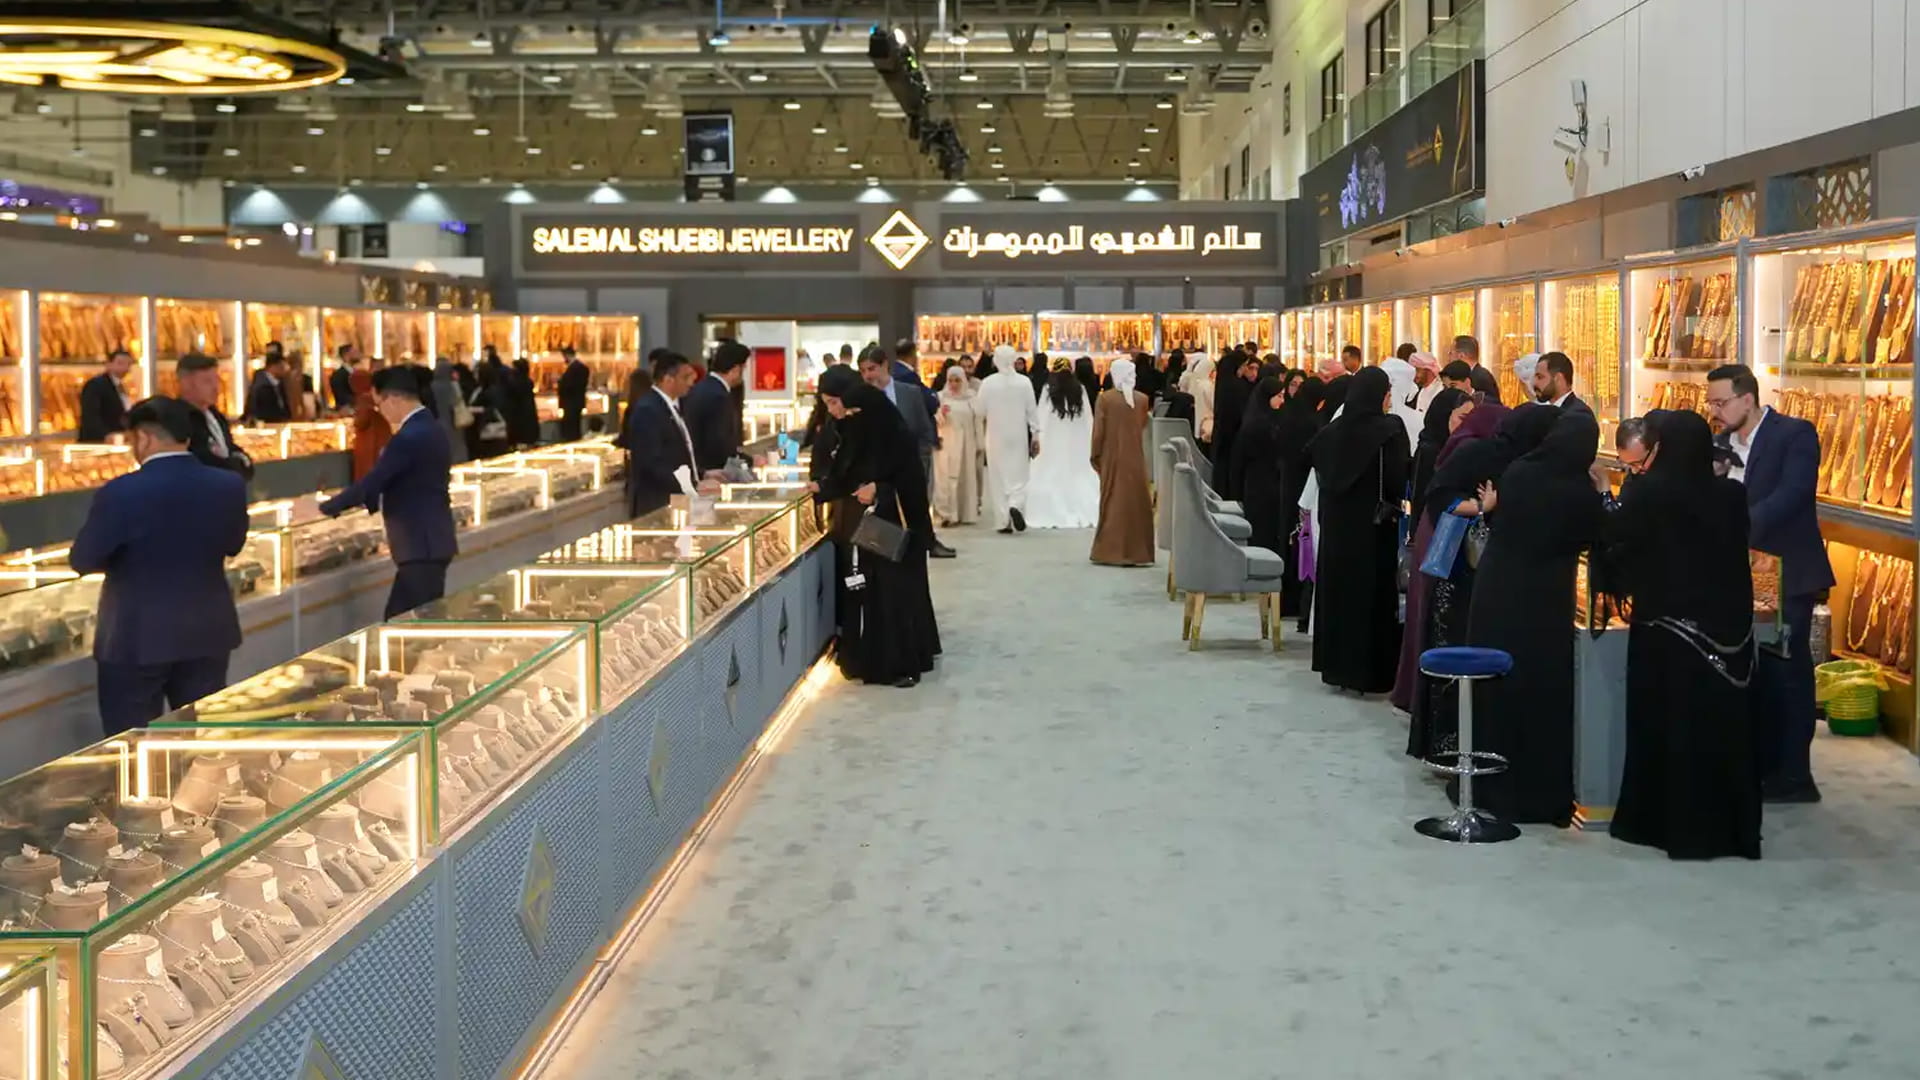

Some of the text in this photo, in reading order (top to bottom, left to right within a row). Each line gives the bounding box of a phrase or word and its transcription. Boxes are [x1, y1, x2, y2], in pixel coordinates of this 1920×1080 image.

[533, 227, 854, 252] SALEM AL SHUEIBI JEWELLERY
[1090, 224, 1195, 254] الشعيبي
[1201, 225, 1262, 256] سالم
